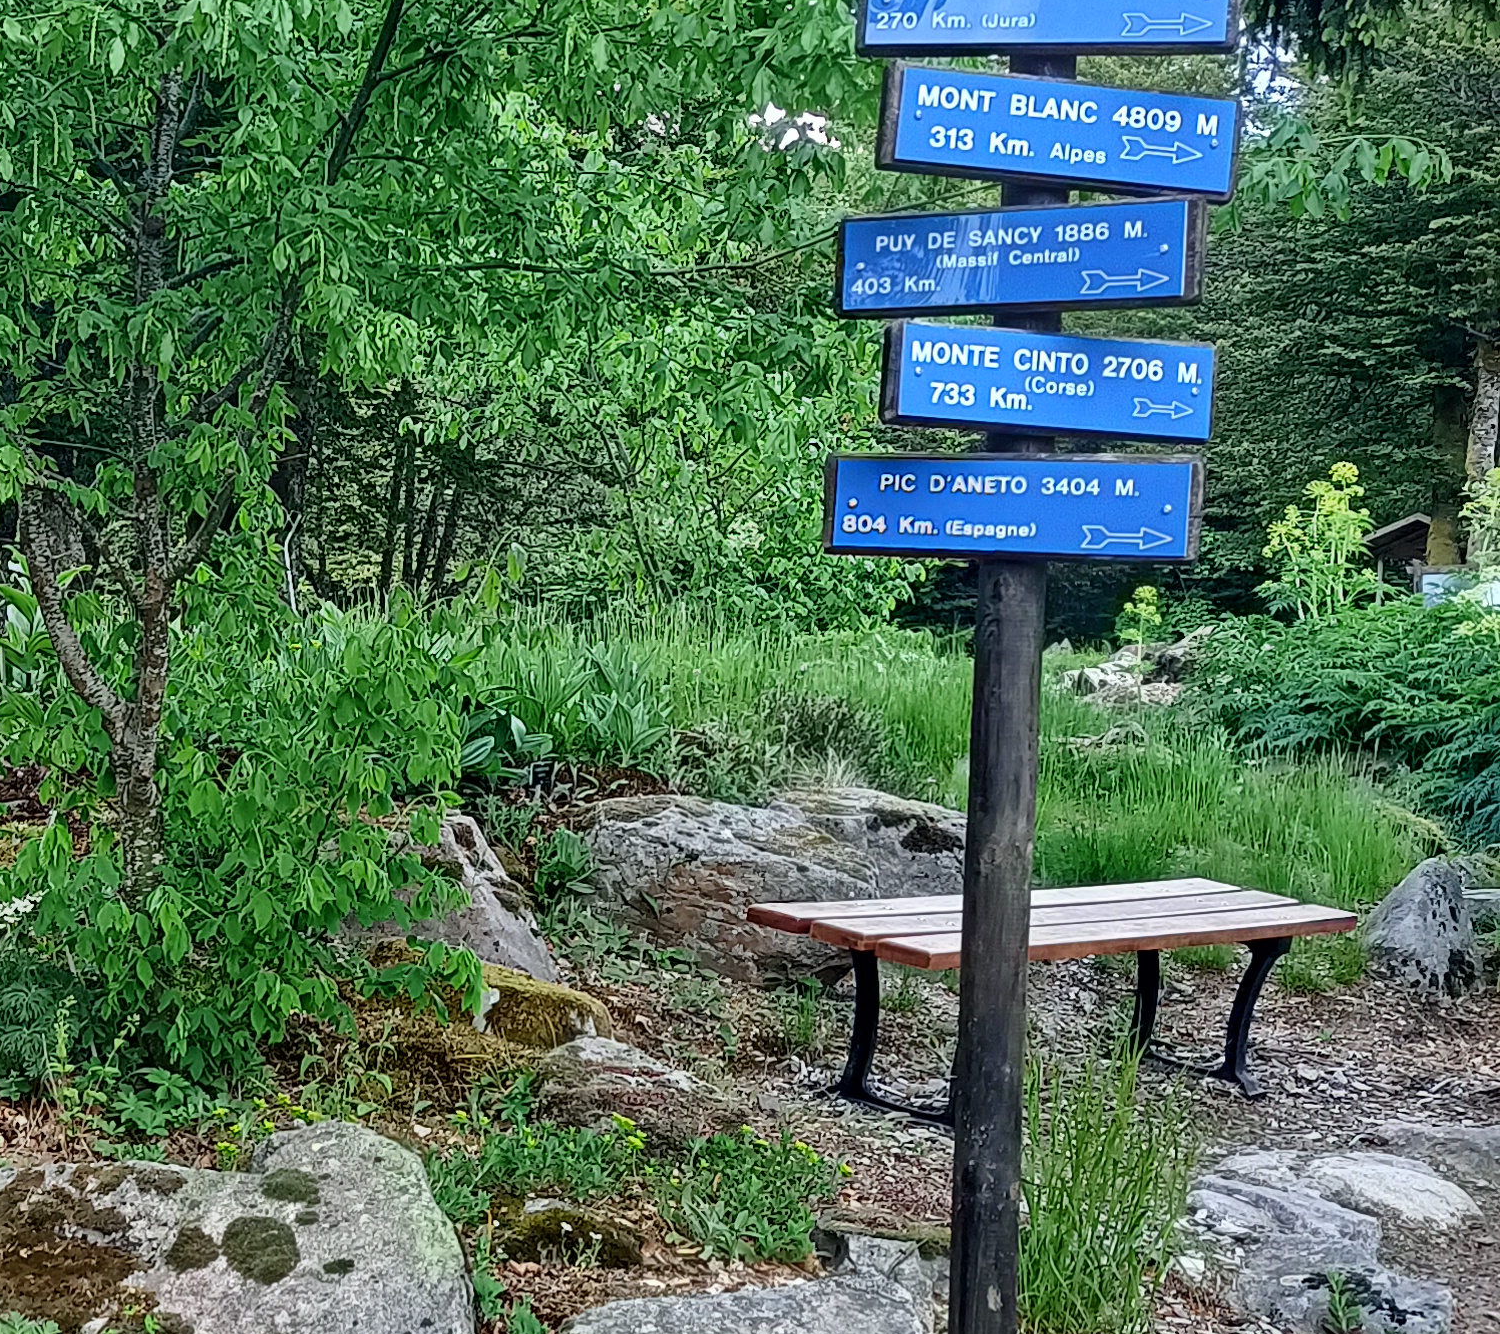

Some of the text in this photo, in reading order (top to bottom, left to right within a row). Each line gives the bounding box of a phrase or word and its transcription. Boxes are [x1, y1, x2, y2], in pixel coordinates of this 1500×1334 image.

[876, 11, 1036, 29] 270 Km. (Jura)
[918, 84, 1218, 137] MONT BLANC 4809 M
[929, 125, 1107, 165] 313 Km. Alpes
[875, 220, 1148, 253] PUY DE SANCY 1886 M.
[936, 247, 1080, 269] (Massif Central)
[851, 275, 941, 295] 403 Km.
[911, 340, 1202, 385] MONTE CINTO 2706 M.
[930, 375, 1095, 411] 733 Km. (Corse)
[879, 473, 1140, 497] PIC D'ANETO 3404 M.
[842, 514, 1037, 539] 804 Km. (Espagne)
